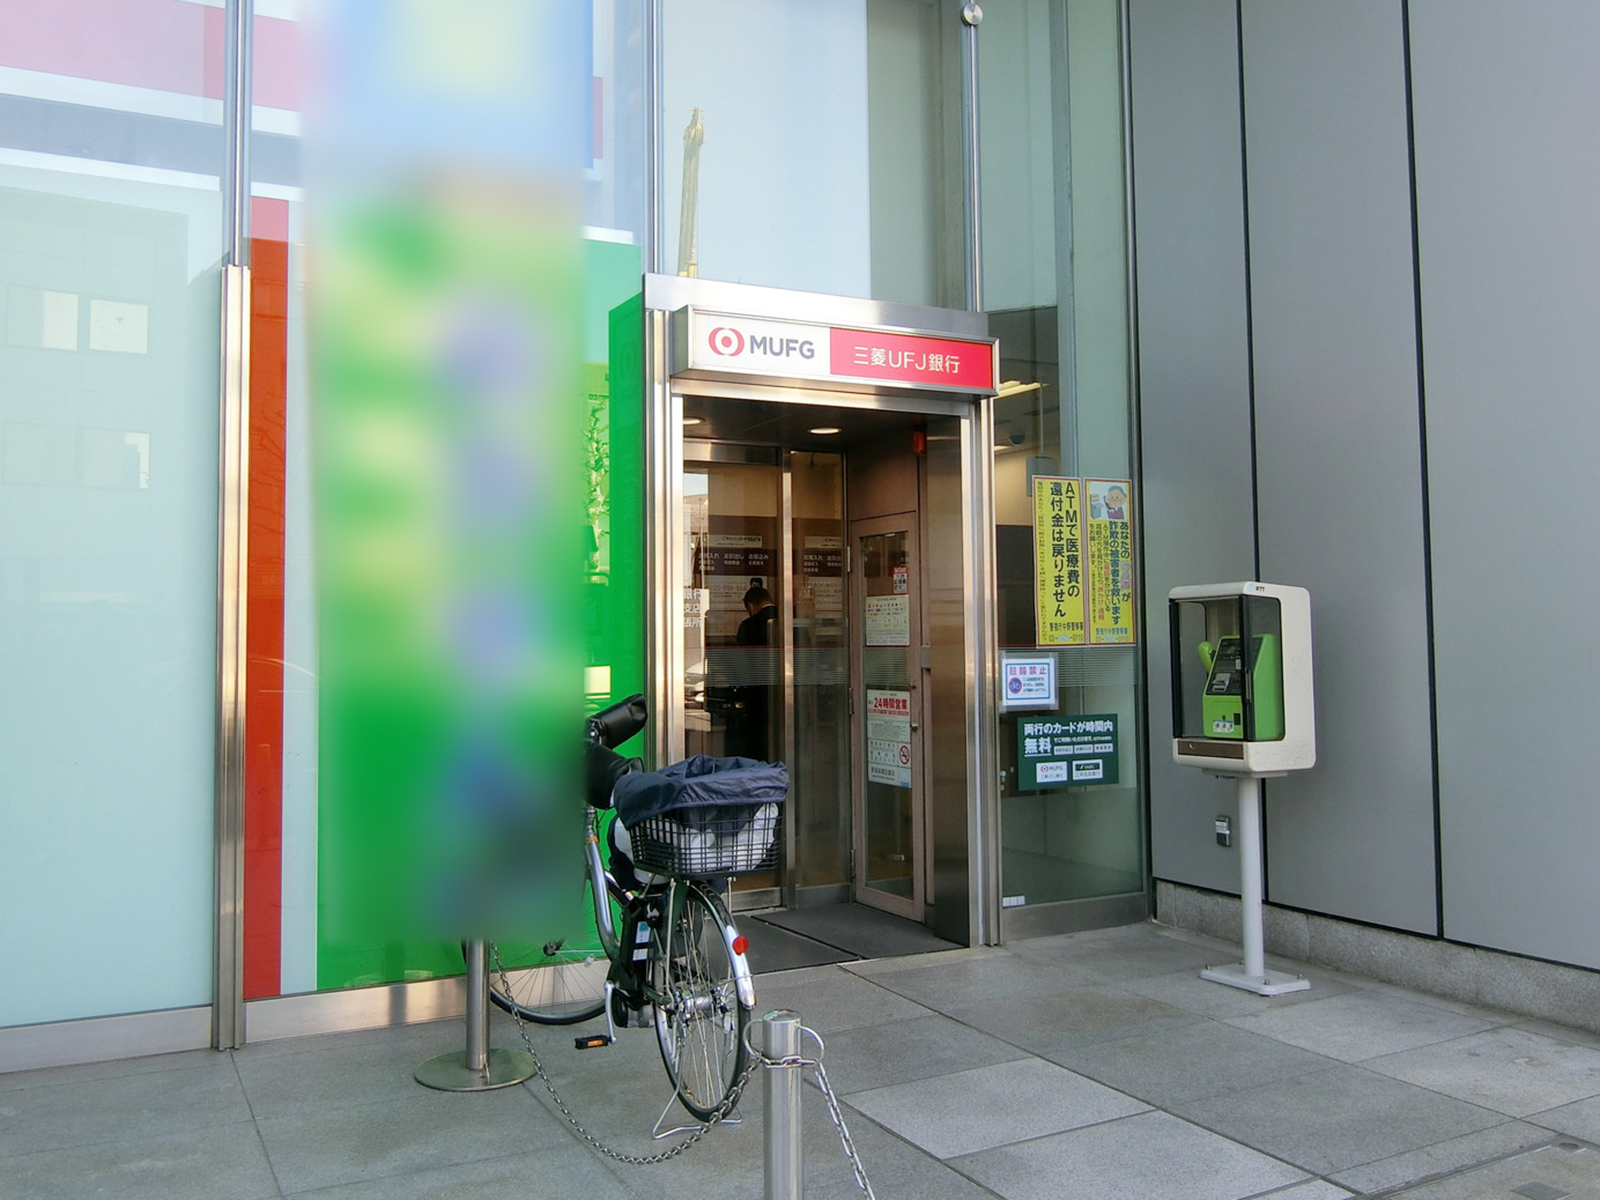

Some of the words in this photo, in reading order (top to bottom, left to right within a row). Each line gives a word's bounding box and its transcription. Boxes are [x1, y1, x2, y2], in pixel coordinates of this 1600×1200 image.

[750, 335, 814, 359] MUFG
[853, 346, 960, 374] 三菱UFJ銀行
[1050, 482, 1066, 617] 還付金は戻りません
[1065, 482, 1080, 598] ATMで医療費の
[1009, 666, 1047, 676] 駐輪禁止
[873, 697, 908, 710] 24時間営業
[1024, 720, 1113, 735] 両行のカードが時間内
[1024, 736, 1052, 754] 無料
